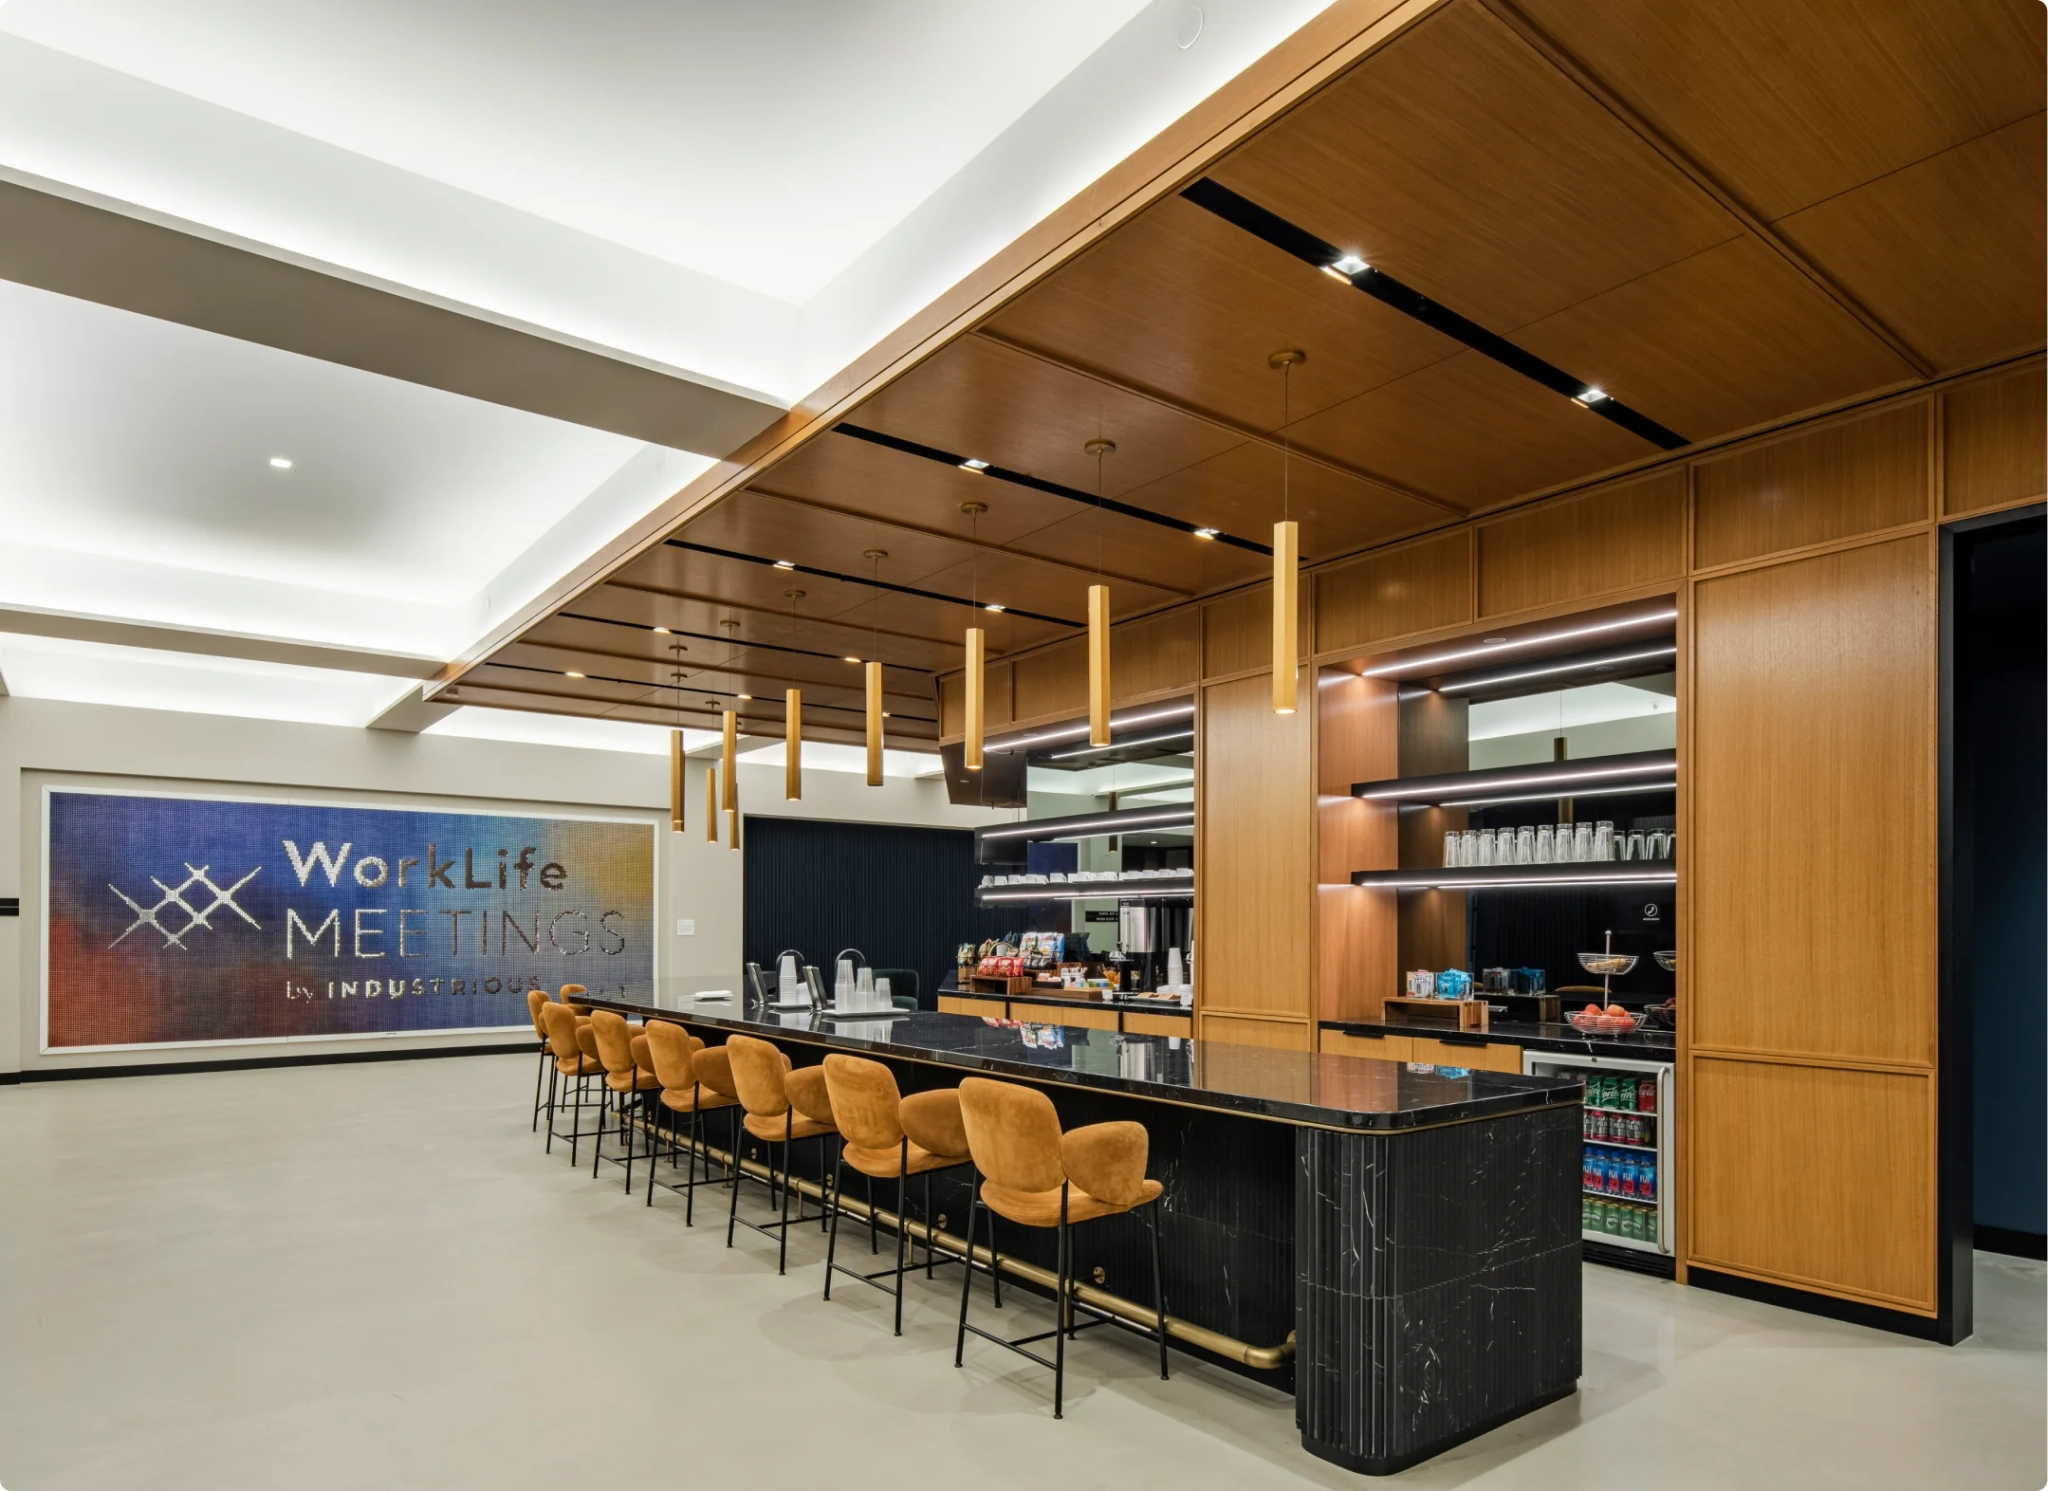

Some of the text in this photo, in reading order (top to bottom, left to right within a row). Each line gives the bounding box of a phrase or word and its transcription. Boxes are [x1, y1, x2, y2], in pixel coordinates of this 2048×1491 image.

[282, 840, 567, 891] WorkLife
[287, 908, 625, 960] MEETINGS
[328, 975, 541, 1000] INDUSTRIOUS
